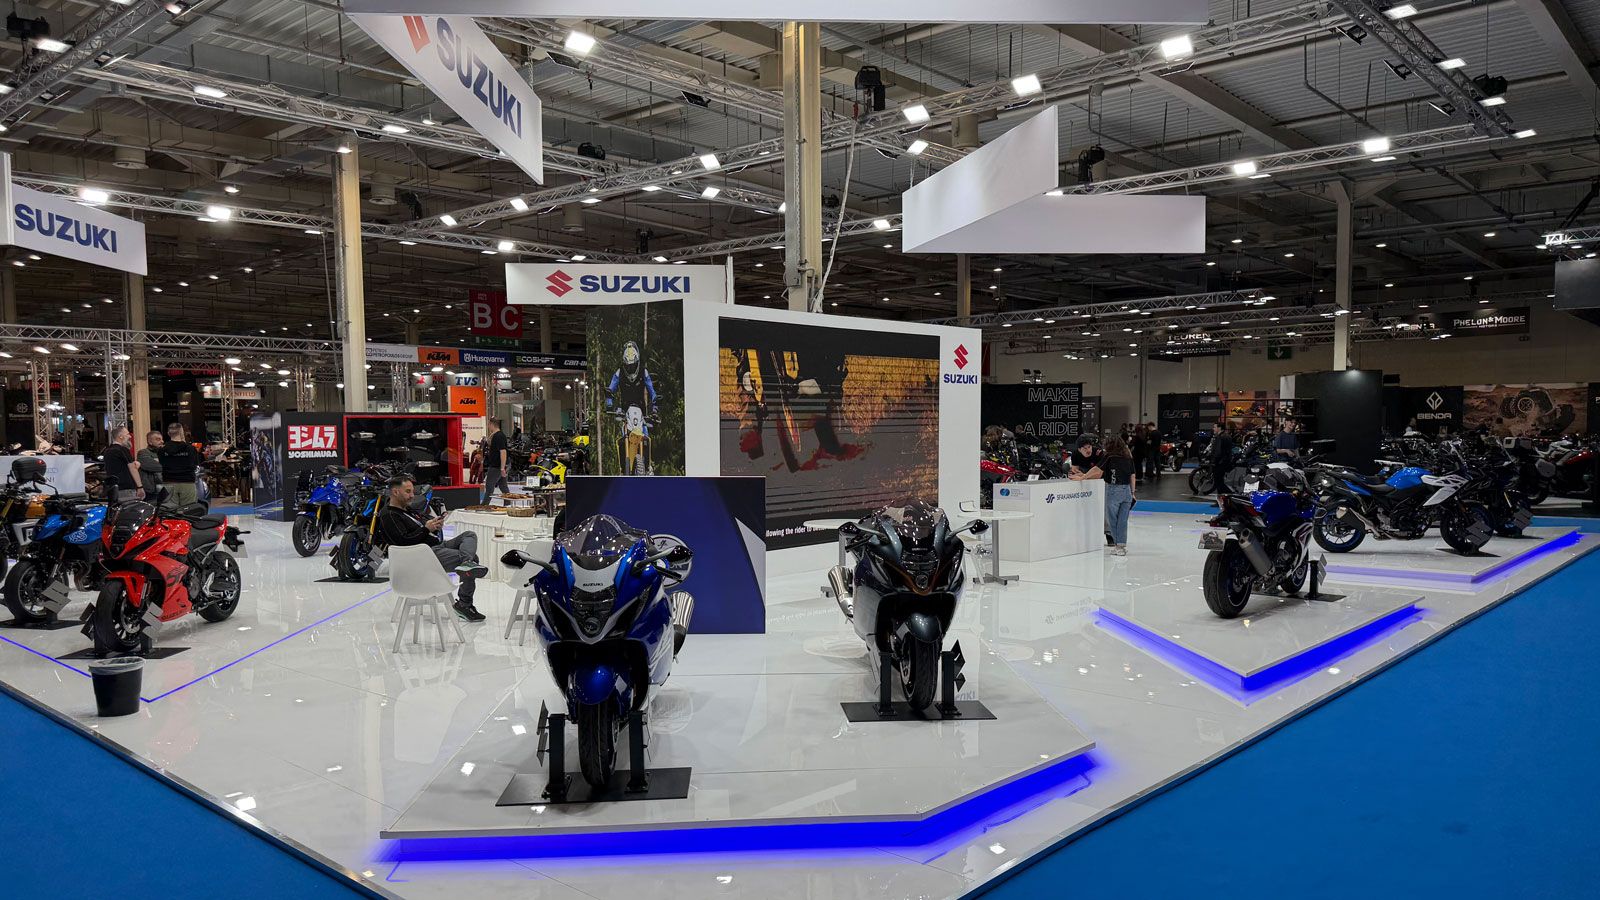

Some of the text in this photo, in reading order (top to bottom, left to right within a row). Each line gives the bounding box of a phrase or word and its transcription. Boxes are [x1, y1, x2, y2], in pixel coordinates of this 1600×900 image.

[436, 17, 522, 139] SUZUKI
[14, 203, 118, 253] SUZUKI
[579, 274, 691, 293] SUZUKI
[473, 302, 519, 330] B C
[426, 352, 451, 361] KTM
[471, 353, 505, 364] Husqvarna
[455, 376, 478, 386] TVS
[943, 373, 978, 384] SUZUKI
[1028, 387, 1079, 402] MAKE
[459, 397, 477, 405] KTM
[1043, 404, 1079, 419] LIFE
[1417, 412, 1452, 420] BENDA
[1023, 421, 1079, 436] A RIDE
[289, 426, 335, 449] ヨシムラ
[288, 450, 338, 459] YOSHIMURA
[1080, 490, 1093, 498] GROUP
[785, 527, 794, 535] the
[794, 526, 806, 534] rider
